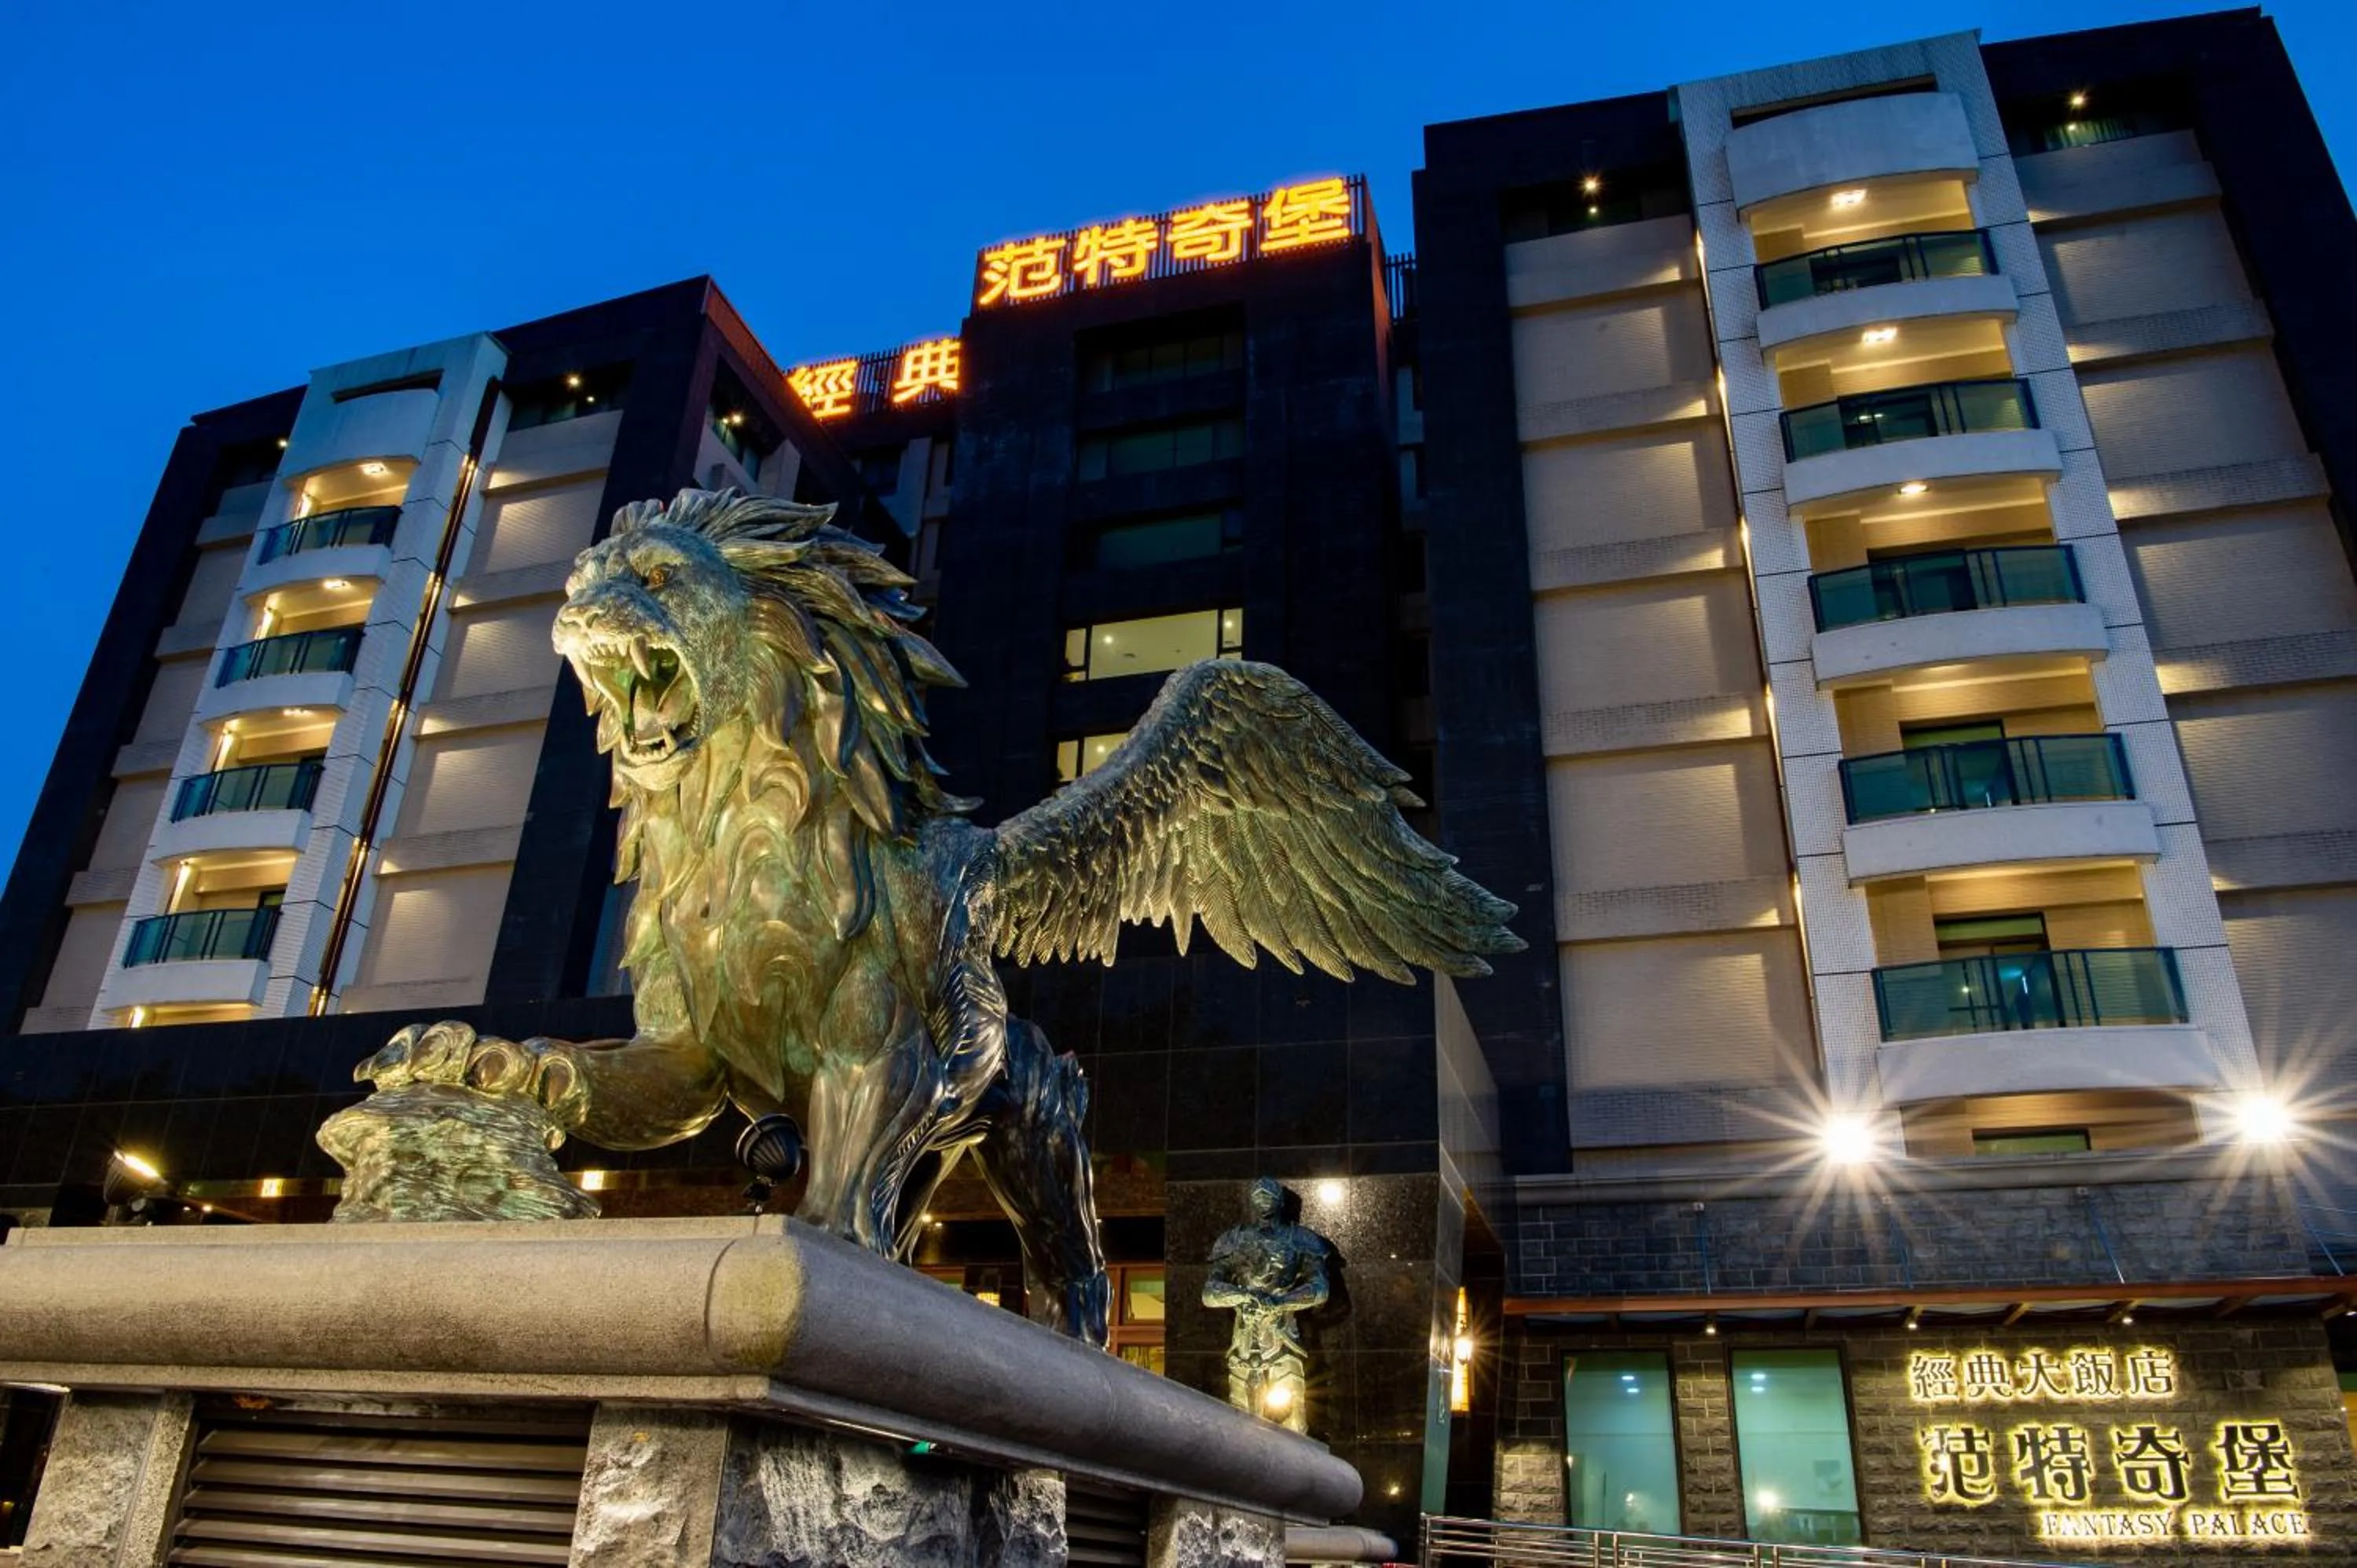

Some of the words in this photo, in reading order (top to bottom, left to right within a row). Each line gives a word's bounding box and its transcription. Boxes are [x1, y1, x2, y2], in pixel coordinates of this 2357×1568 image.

[979, 178, 1352, 306] 范特奇堡
[787, 339, 962, 419] 經典
[1912, 1350, 2175, 1399] 經典大飯店
[1922, 1423, 2301, 1502] 范特奇堡
[2044, 1512, 2172, 1536] FANTASY
[2191, 1512, 2308, 1536] PALACE
